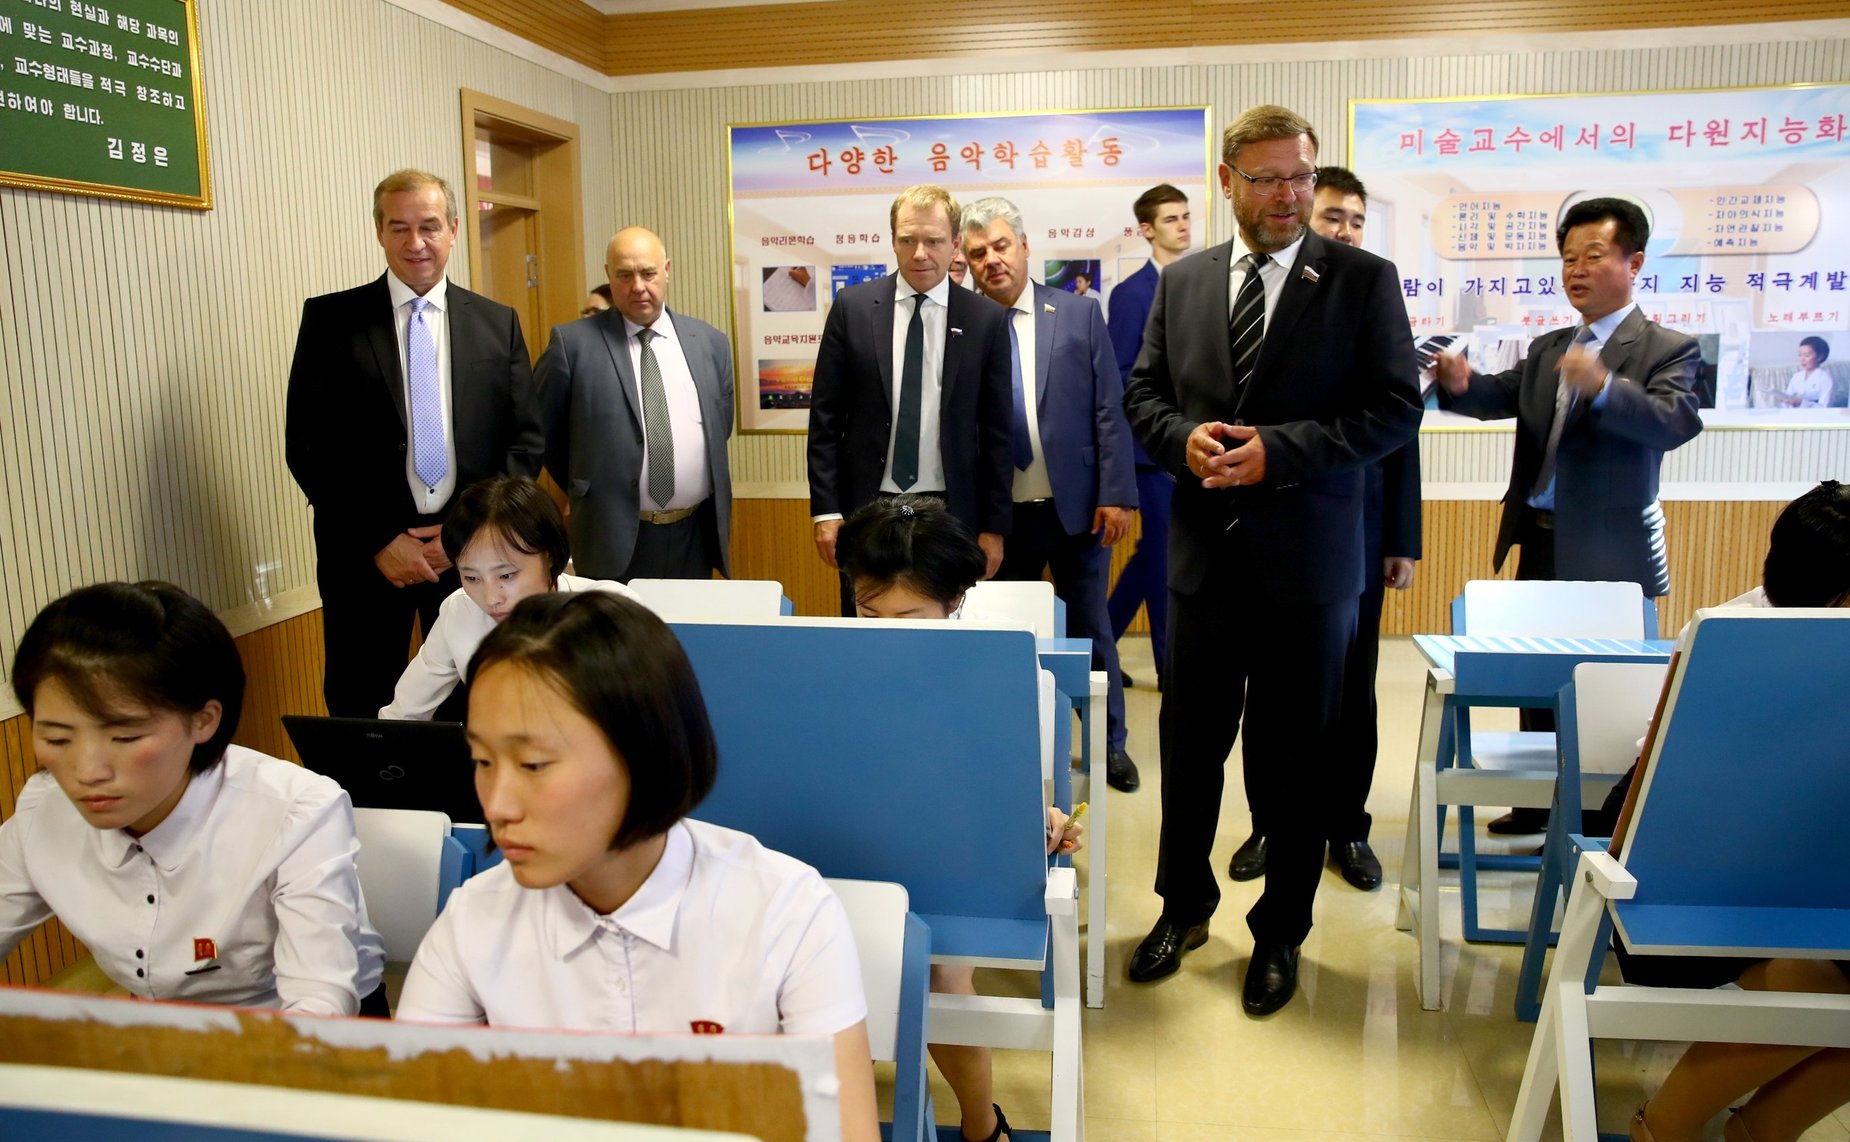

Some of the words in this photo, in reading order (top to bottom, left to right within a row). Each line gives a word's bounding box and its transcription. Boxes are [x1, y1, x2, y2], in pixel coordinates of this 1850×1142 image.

[70, 0, 109, 25] 현실과
[117, 14, 140, 34] 해당
[146, 23, 179, 46] 과목의
[22, 21, 52, 44] 맞는
[61, 32, 117, 62] 교수과정,
[127, 50, 182, 78] 교수수단과
[15, 56, 94, 89] 교수형태들을
[100, 77, 126, 96] 적극
[136, 85, 186, 110] 창조하고
[63, 103, 104, 125] 합니다.
[1400, 122, 1635, 155] 미술교수에서의
[1668, 114, 1847, 147] 다원지능화
[807, 145, 898, 176] 다양한
[927, 137, 1123, 172] 음악학습활동
[1464, 276, 1565, 296] 가지고있
[1680, 274, 1726, 293] 지능
[1746, 271, 1848, 291] 적극계발
